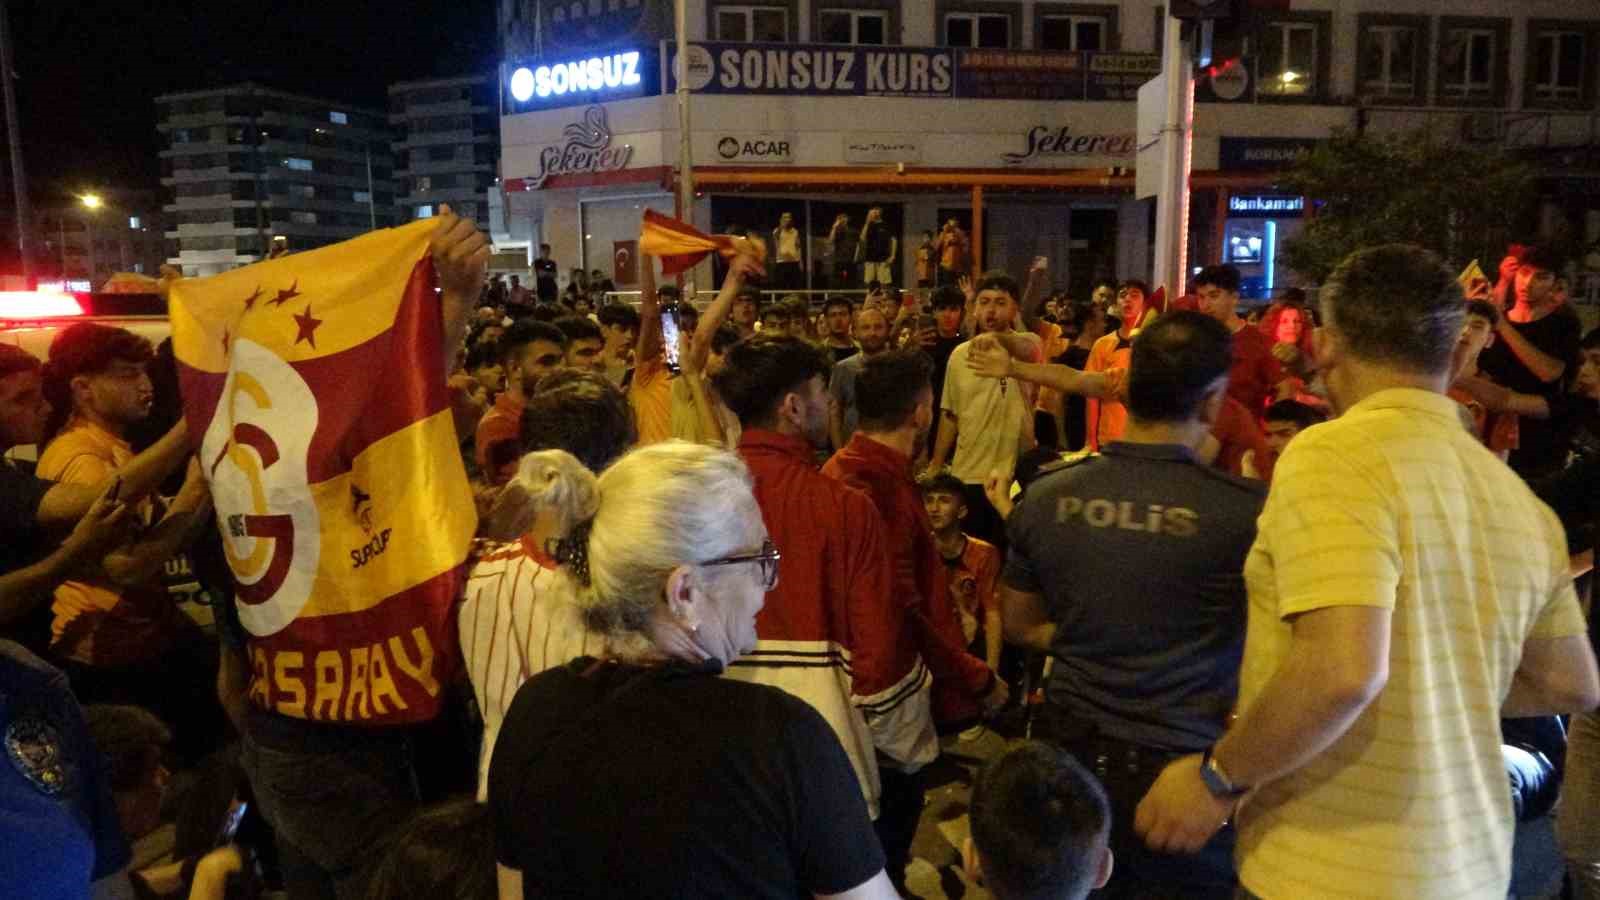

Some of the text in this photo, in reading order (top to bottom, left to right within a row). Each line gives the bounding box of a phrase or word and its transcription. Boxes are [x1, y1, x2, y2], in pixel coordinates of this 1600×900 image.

[535, 51, 641, 97] SONSUZ
[720, 49, 855, 91] SONSUZ
[866, 52, 951, 92] KURS
[741, 140, 791, 156] ACAR
[247, 626, 440, 720] ASARAY
